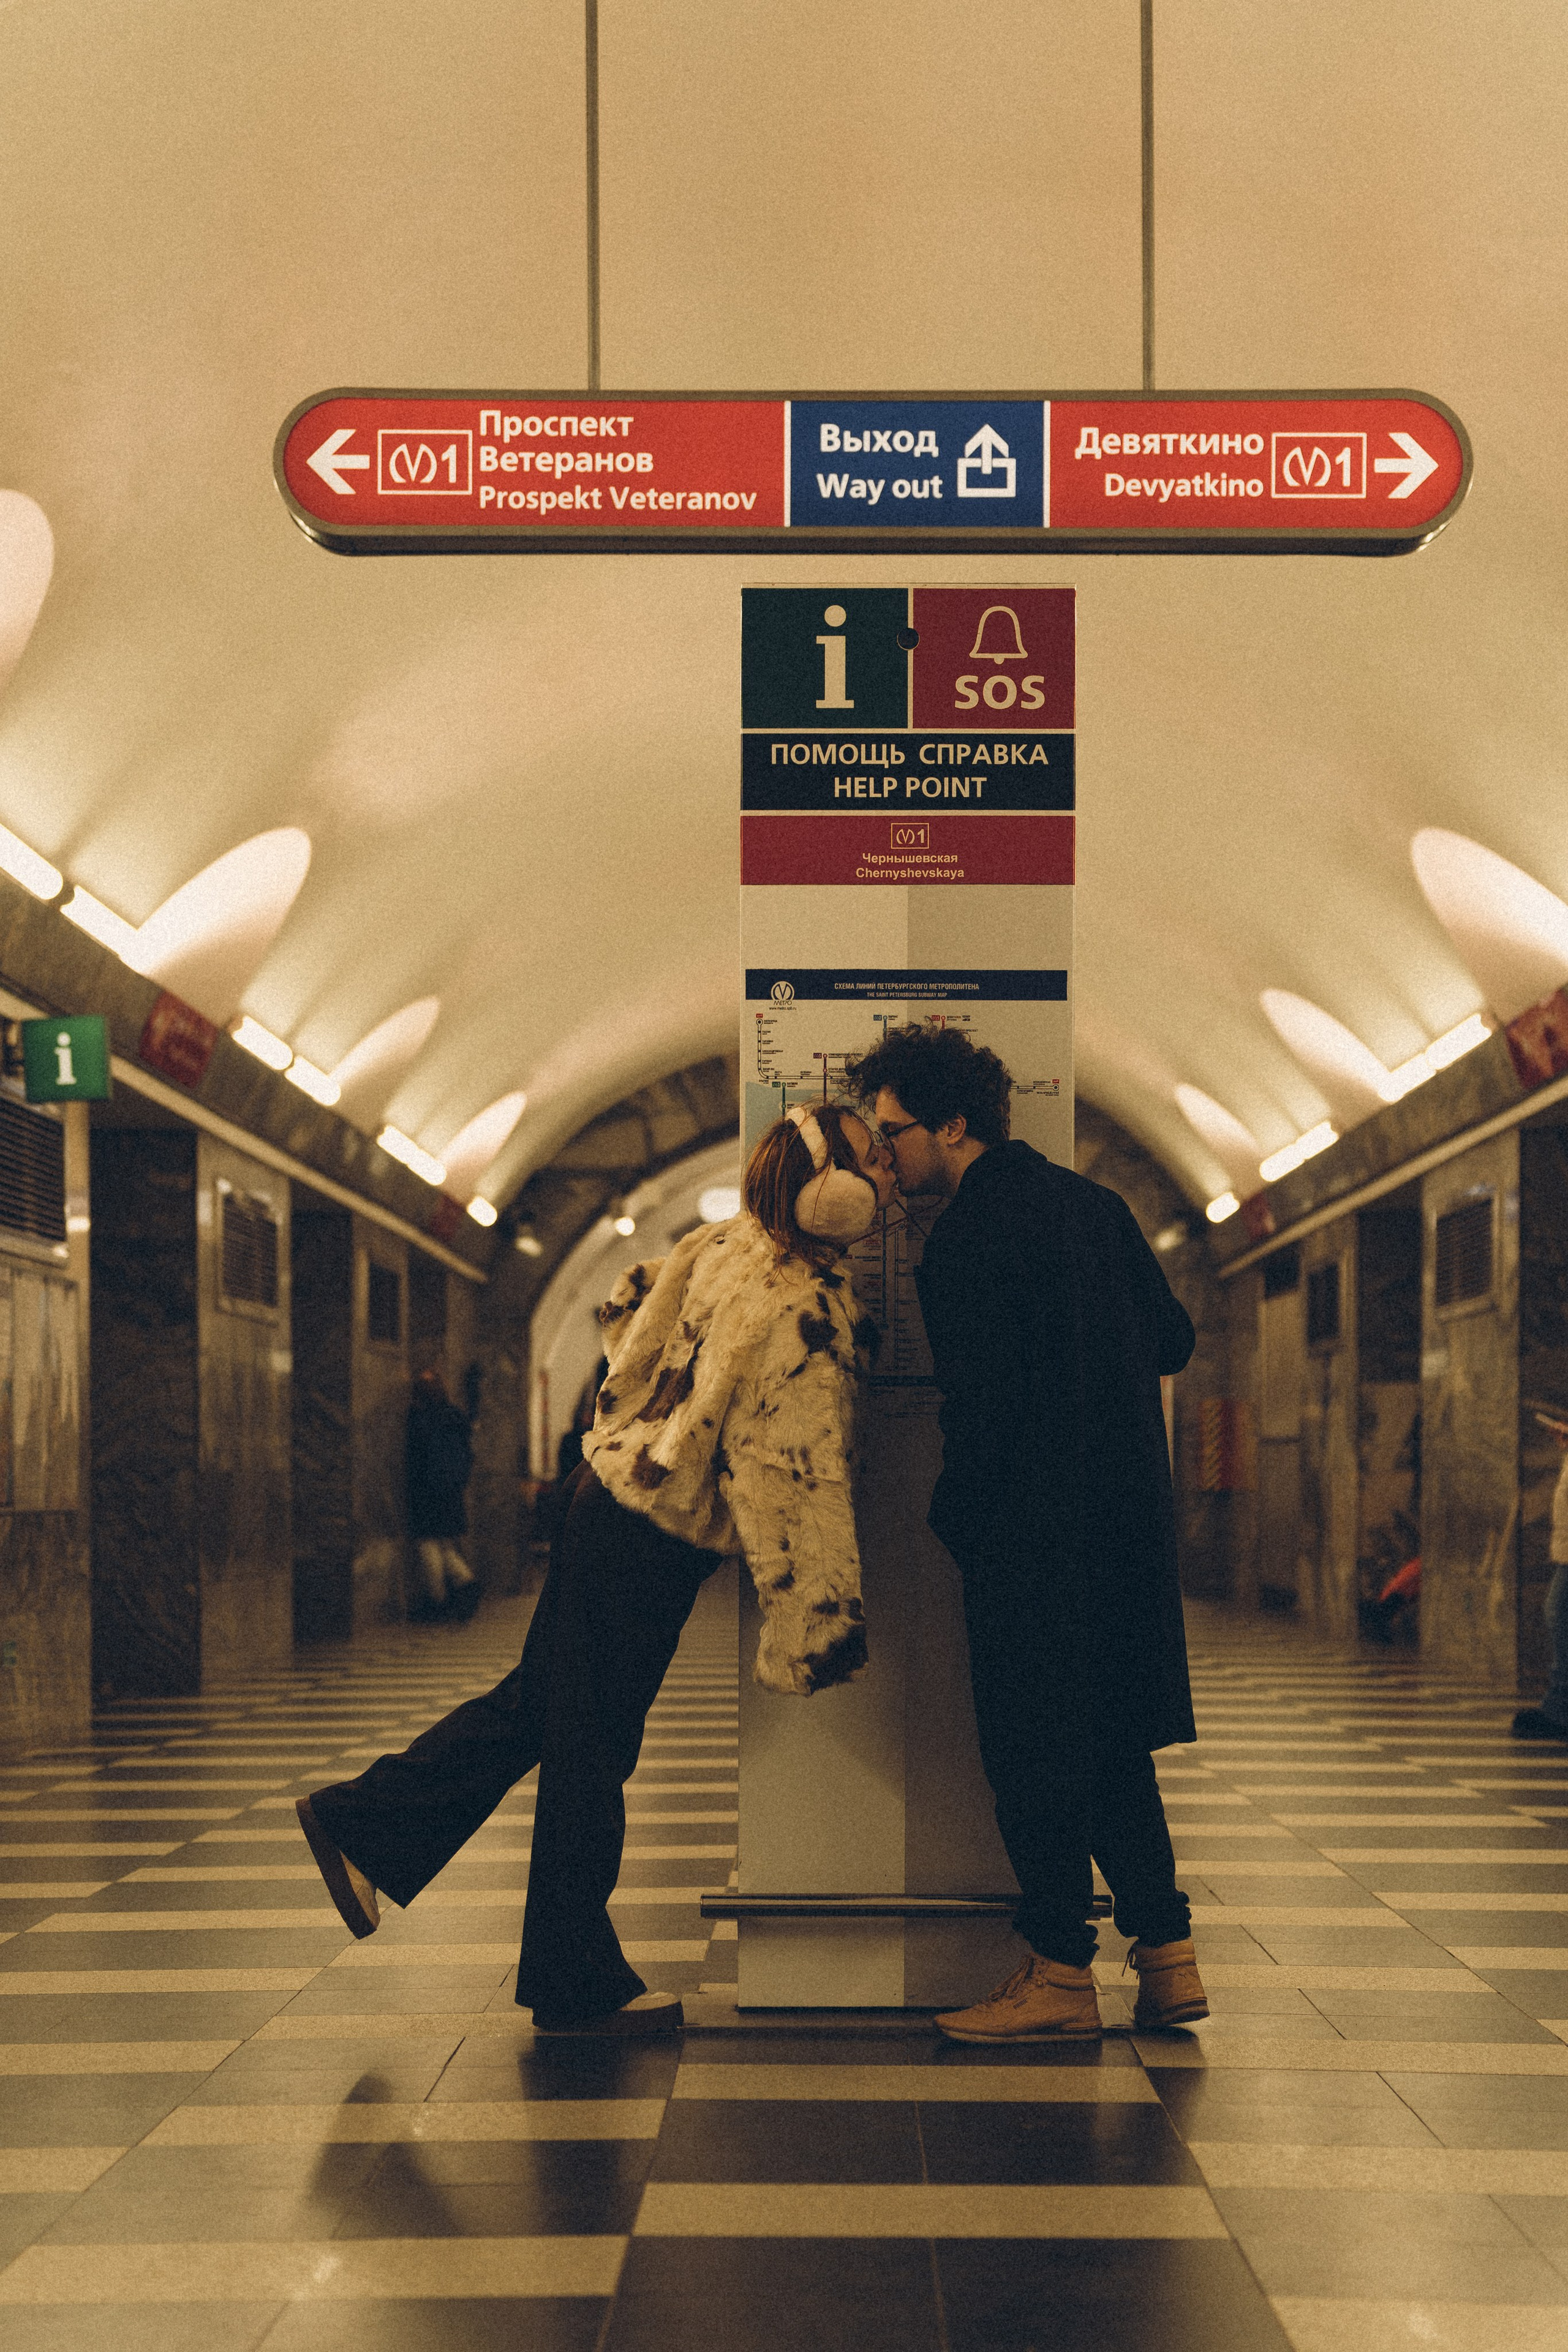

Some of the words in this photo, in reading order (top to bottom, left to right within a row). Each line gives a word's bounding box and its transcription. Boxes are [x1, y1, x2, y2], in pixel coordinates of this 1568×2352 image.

[480, 409, 634, 443] Проспект
[820, 423, 939, 458] Выход
[1074, 427, 1264, 460] Девяткино
[480, 445, 654, 480] Ветеранов
[479, 484, 602, 515] Prospekt
[609, 486, 757, 510] Veteranov
[816, 473, 886, 505] Way
[892, 475, 943, 499] out
[1105, 472, 1264, 503] Devyatkino
[954, 674, 1046, 710] SOS
[771, 744, 905, 769] ПОМОЩЬ
[919, 744, 1049, 765] СПРАВКА
[834, 777, 898, 798] HELP
[906, 777, 987, 798] POINT
[856, 867, 965, 880] Chernyshevskaya
[862, 853, 958, 865] Чернышевская
[855, 981, 876, 990] ЛИНИЙ
